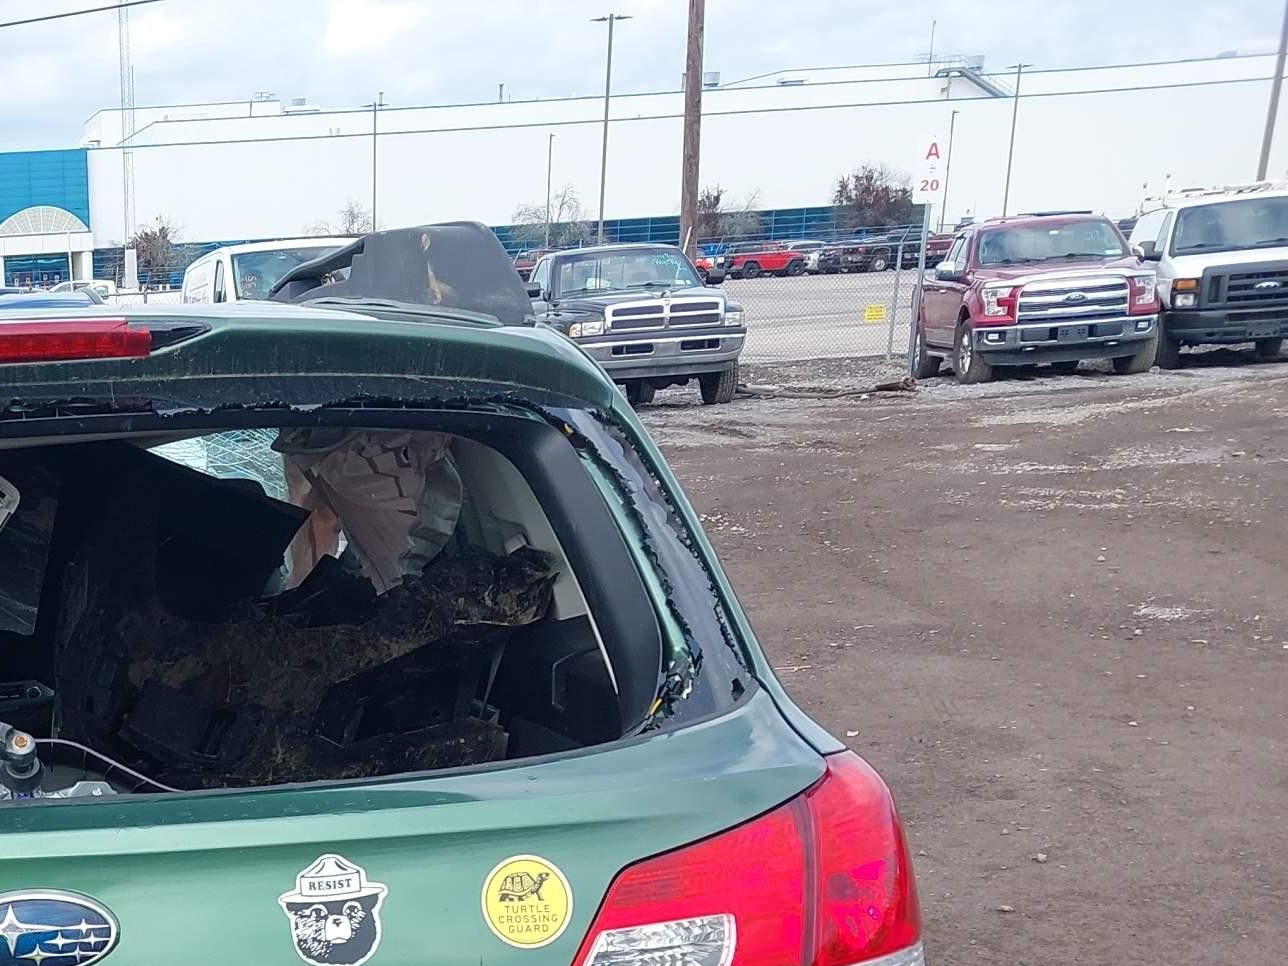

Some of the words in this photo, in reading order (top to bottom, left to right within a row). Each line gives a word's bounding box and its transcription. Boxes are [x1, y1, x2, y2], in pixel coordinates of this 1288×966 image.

[925, 142, 940, 160] A
[920, 179, 940, 191] 20
[309, 878, 353, 891] RESIST
[504, 904, 551, 914] TURTLE
[498, 914, 559, 924] CROSSING
[508, 924, 550, 934] GUARD
